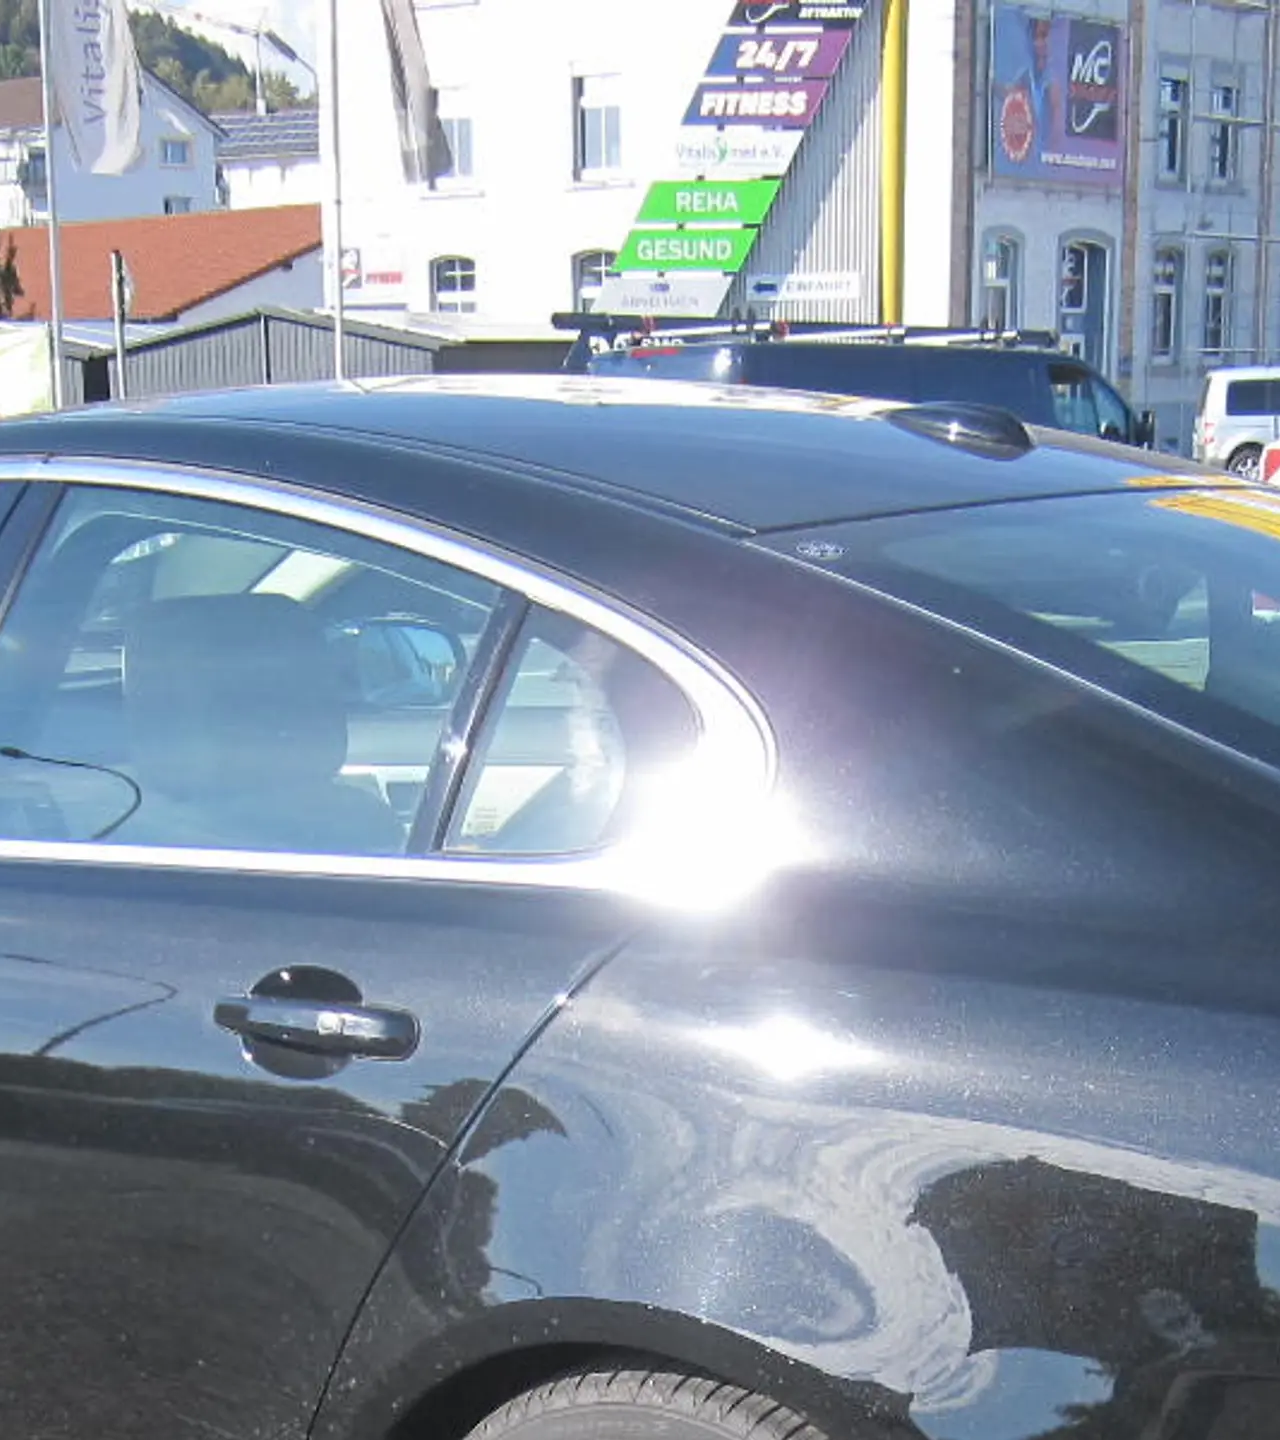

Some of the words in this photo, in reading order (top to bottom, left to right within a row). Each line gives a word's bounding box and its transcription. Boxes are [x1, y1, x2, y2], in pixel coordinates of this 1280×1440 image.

[736, 40, 819, 71] 24/7
[699, 91, 808, 116] FITNESS
[675, 191, 738, 213] REHA
[637, 239, 732, 261] GESUND
